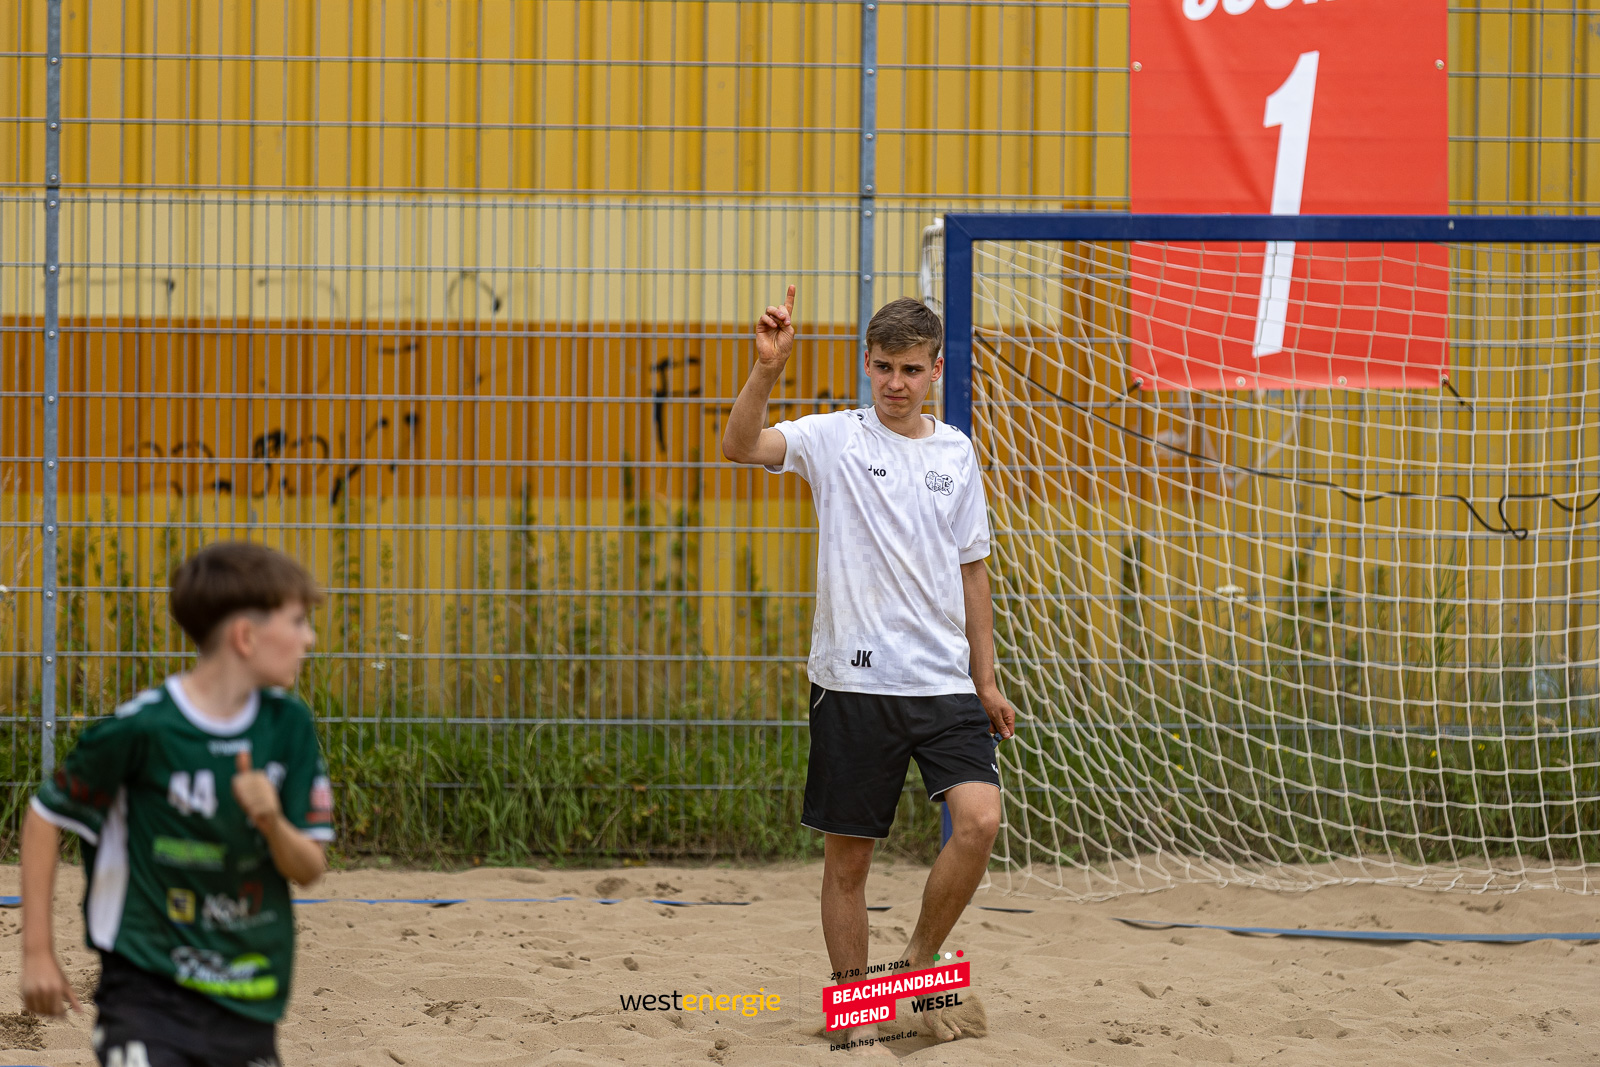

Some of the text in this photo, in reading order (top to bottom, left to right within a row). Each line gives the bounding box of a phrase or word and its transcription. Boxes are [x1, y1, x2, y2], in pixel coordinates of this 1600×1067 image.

[1252, 50, 1320, 358] 1
[867, 464, 887, 477] JKO
[850, 649, 873, 668] JK
